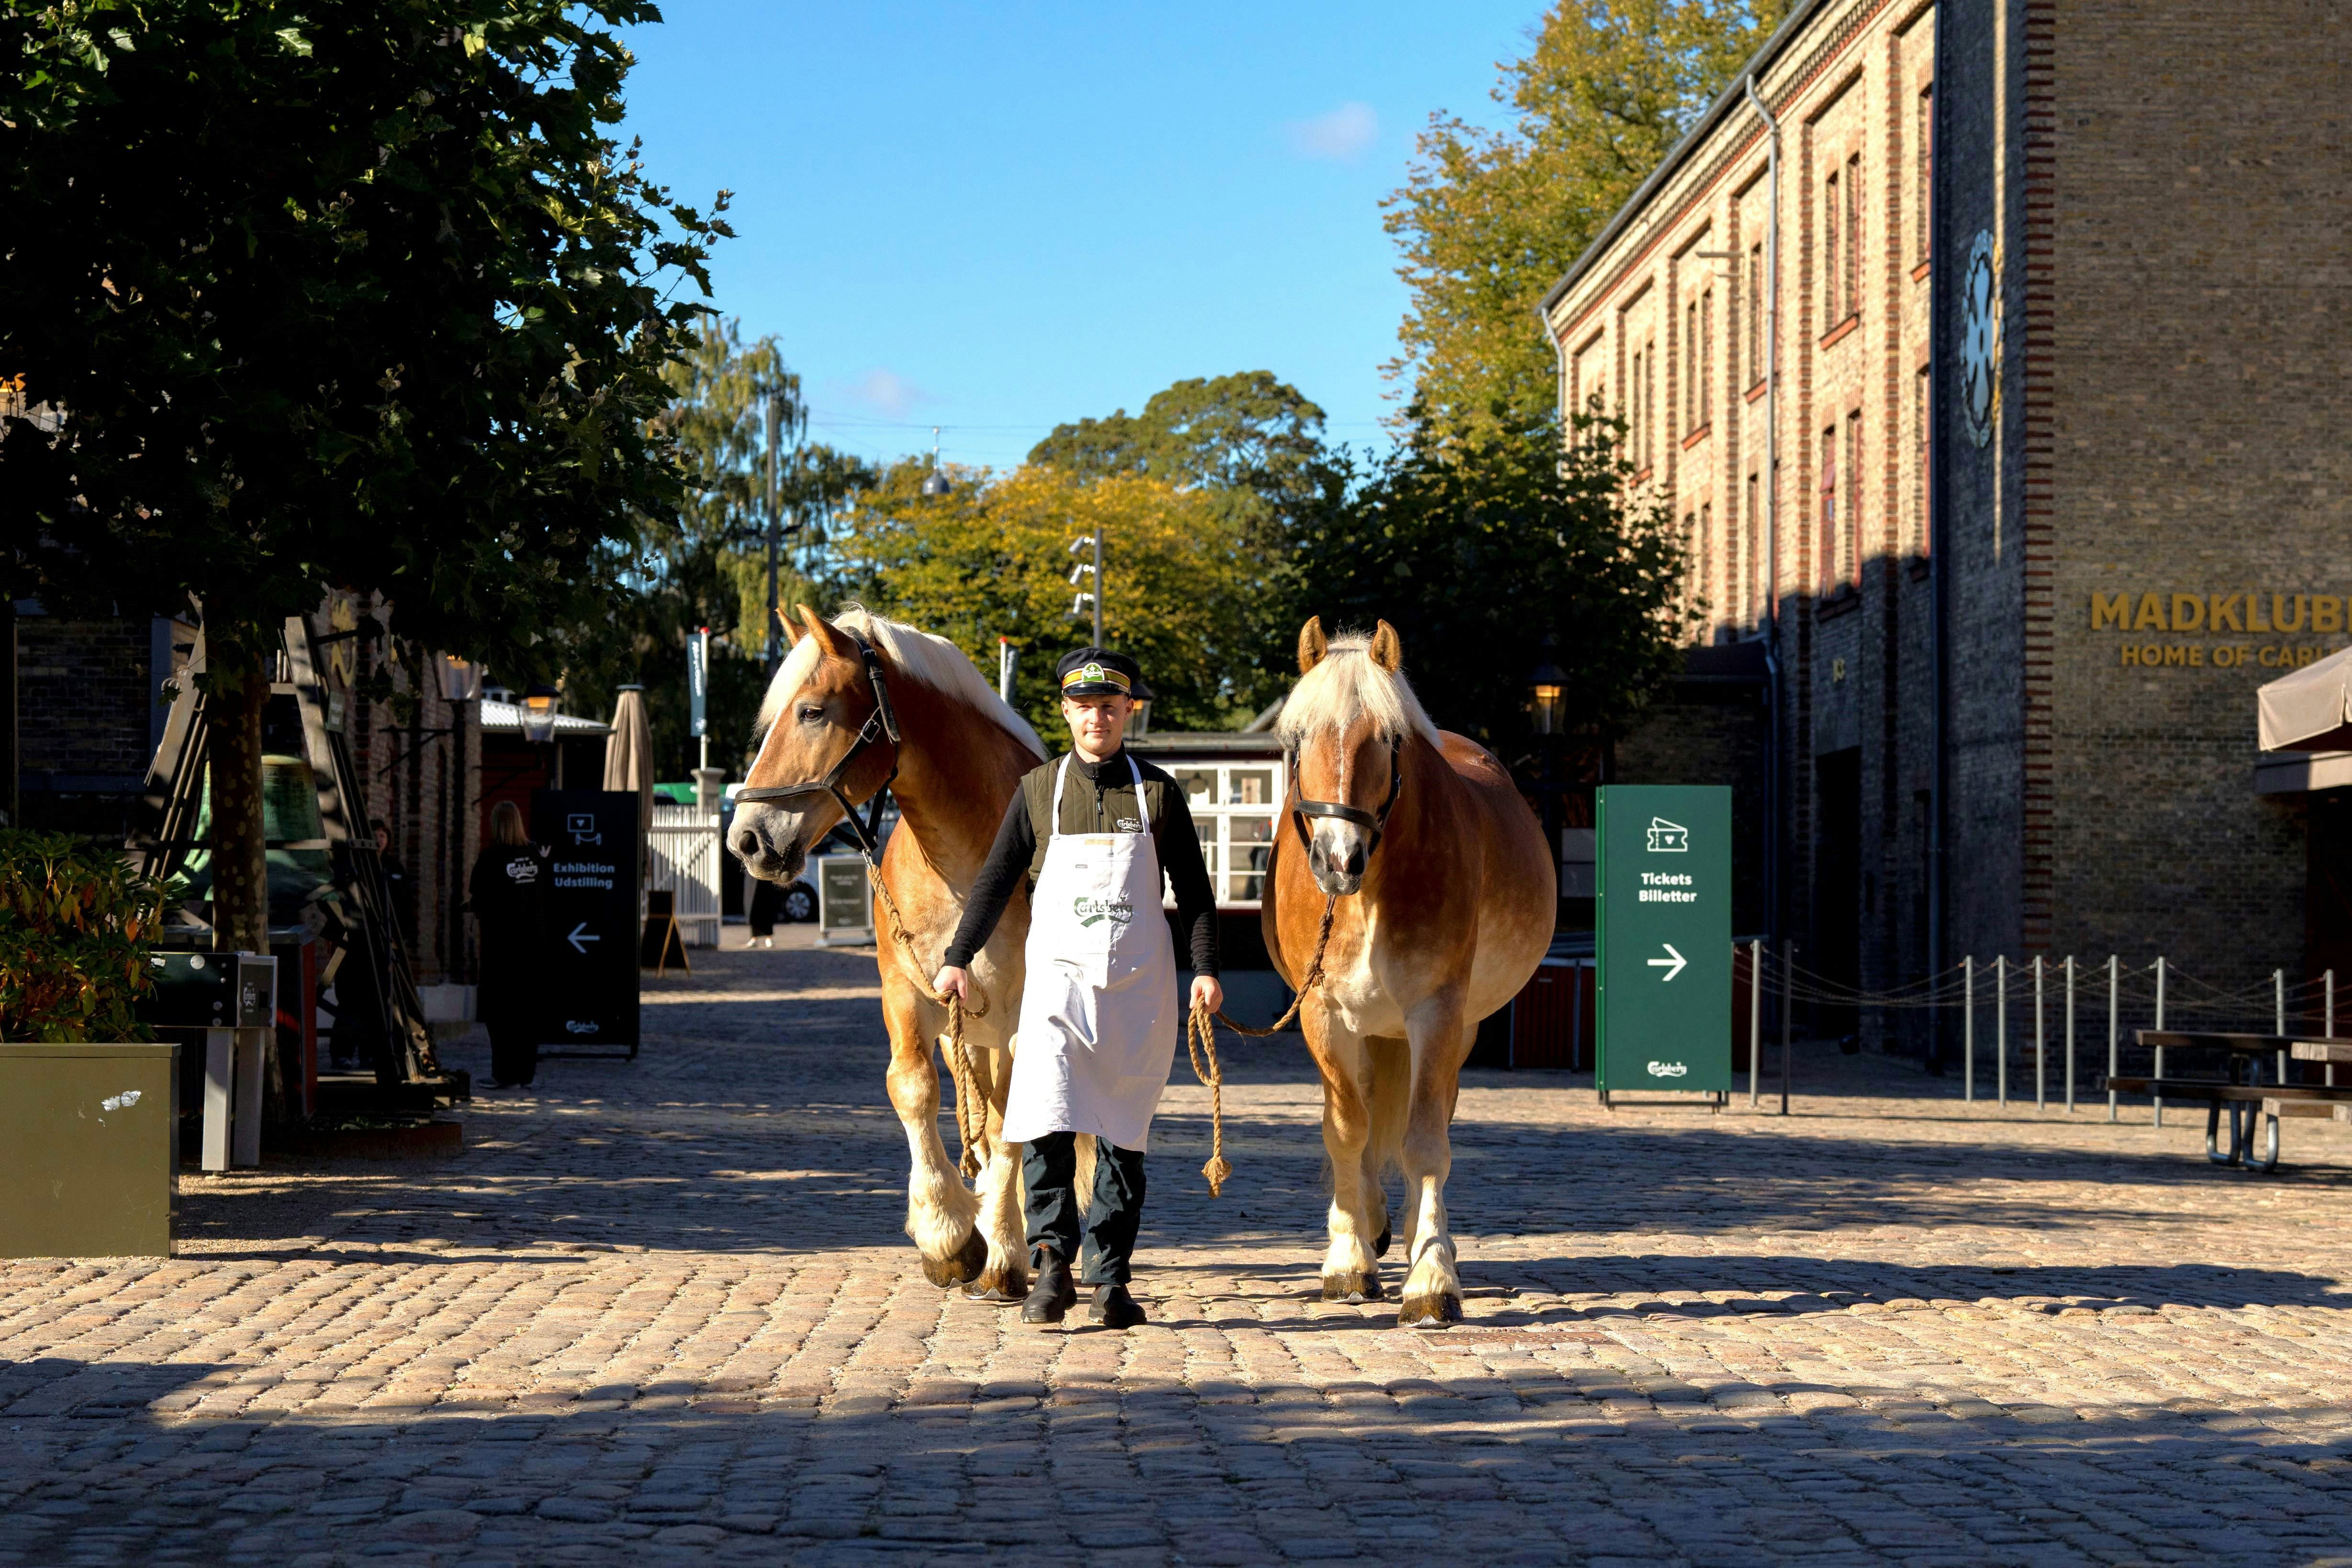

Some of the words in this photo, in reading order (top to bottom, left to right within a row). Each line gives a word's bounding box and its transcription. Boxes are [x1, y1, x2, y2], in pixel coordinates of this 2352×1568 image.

[2091, 592, 2352, 633] MADKLUB
[2121, 645, 2202, 667] HOME
[2213, 646, 2249, 667] OF
[1117, 819, 1142, 831] Carlsberg
[506, 861, 538, 879] Carlsberg
[553, 862, 615, 873] Exhibition
[555, 877, 613, 890] Udstilling
[1641, 872, 1692, 885] Tickets
[1639, 889, 1697, 902] Billetter
[1074, 896, 1134, 928] Carlsberg
[1647, 1061, 1687, 1077] Carlsberg
